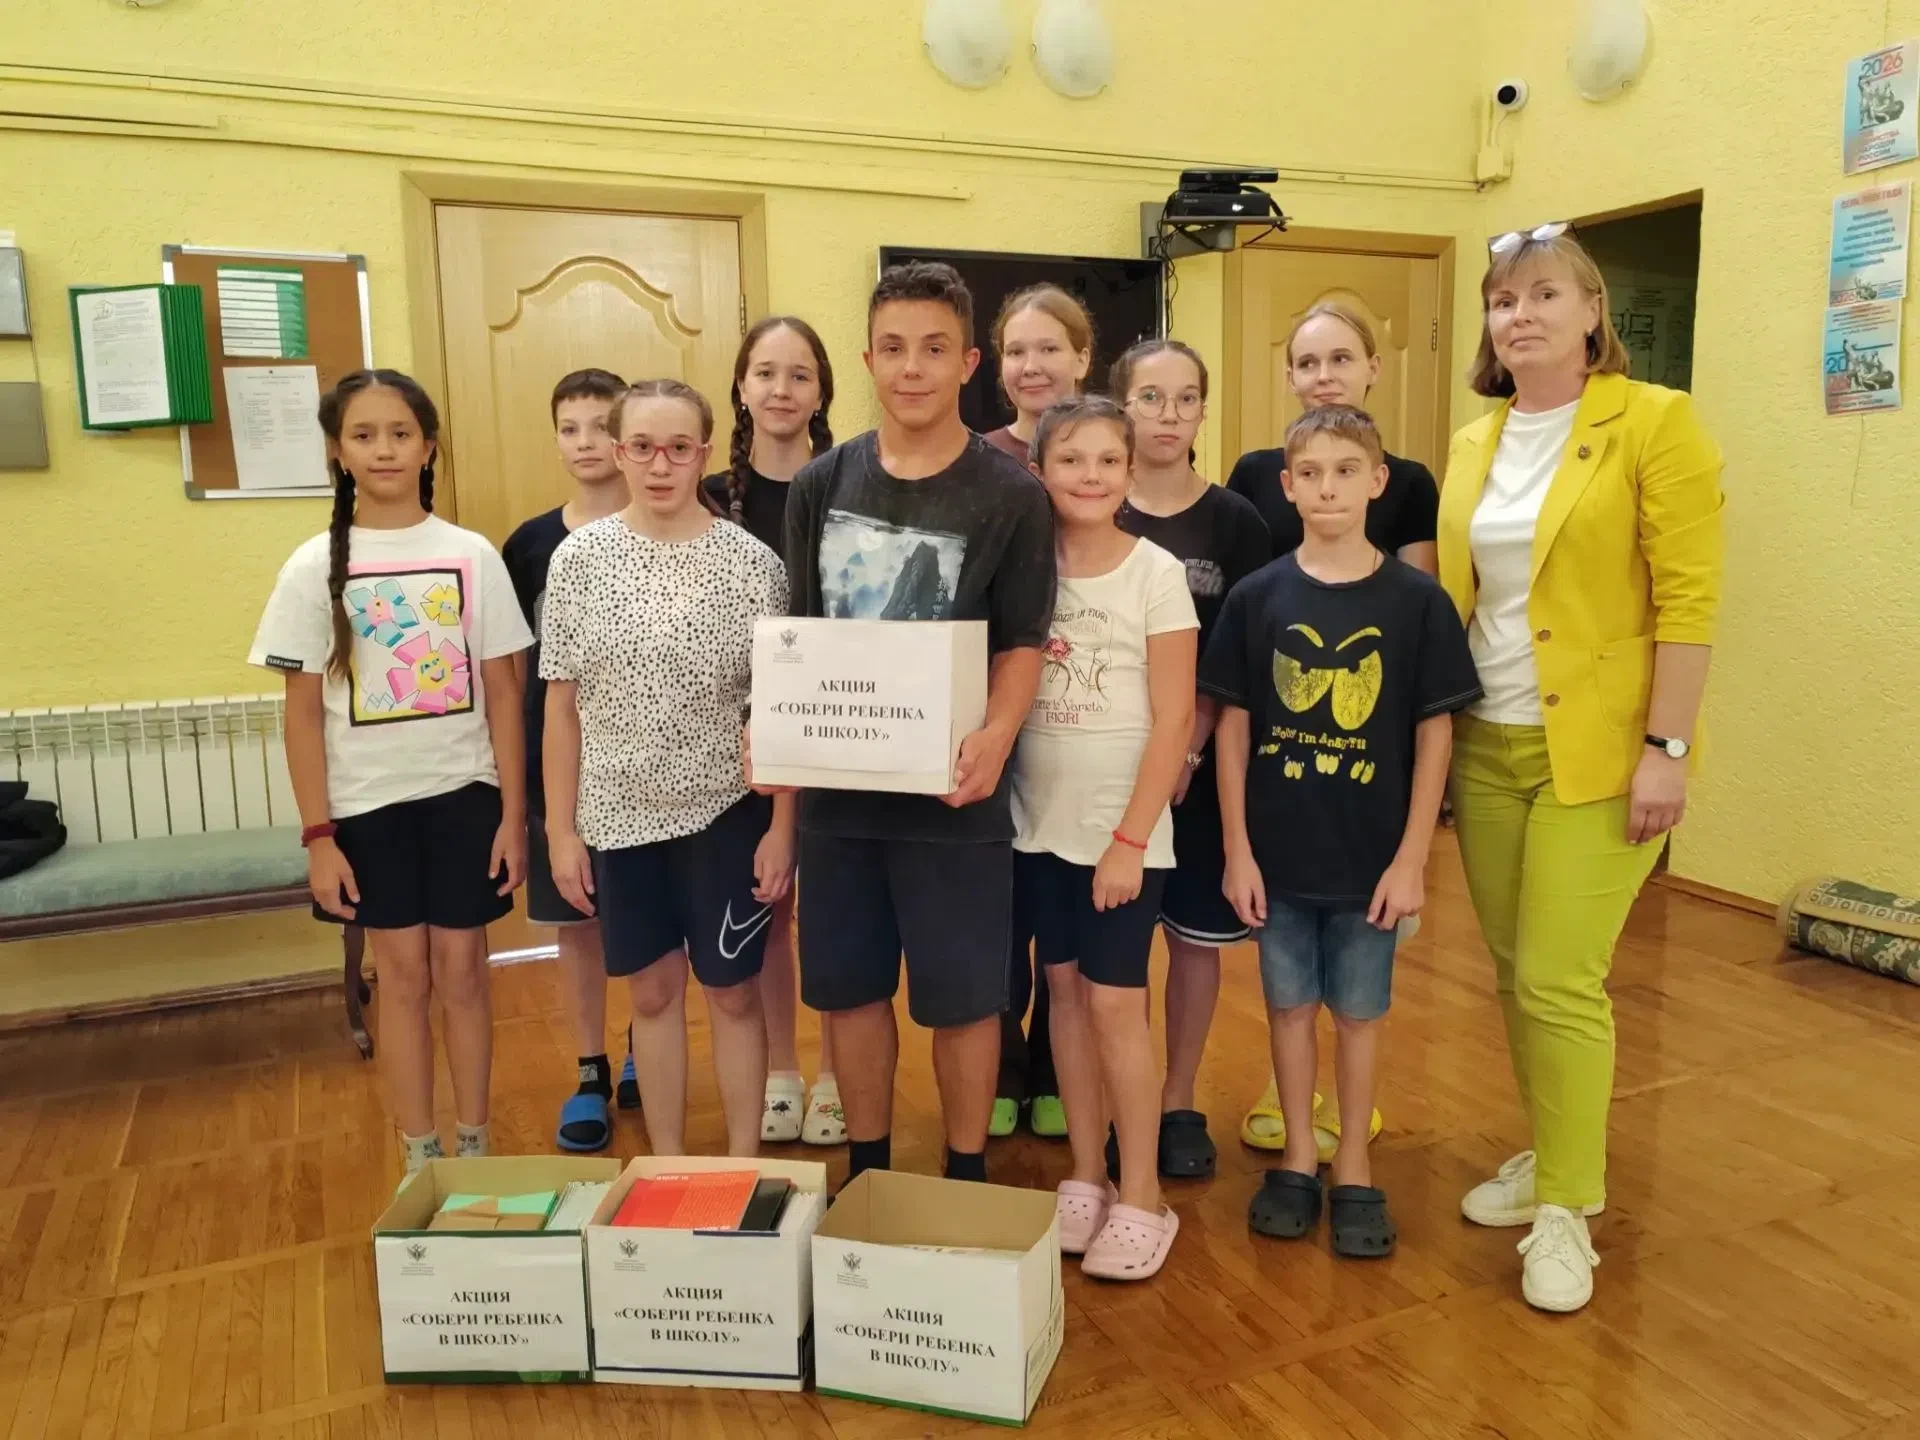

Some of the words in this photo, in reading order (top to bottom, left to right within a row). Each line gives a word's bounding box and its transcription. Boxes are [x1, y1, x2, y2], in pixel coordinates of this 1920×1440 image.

[1861, 52, 1904, 77] 2026
[1088, 607, 1108, 624] FIORI
[818, 679, 876, 694] АКЦИЯ
[770, 701, 843, 717] «СОБЕРИ
[848, 704, 925, 720] РЕБЕНКА
[1046, 711, 1079, 724] FIORI
[803, 725, 813, 737] В
[818, 725, 890, 741] ШКОЛУ»
[1298, 732, 1316, 744] I'm
[450, 1291, 510, 1305] АКЦИЯ
[663, 1286, 722, 1301] АКЦИЯ
[402, 1313, 478, 1326] «СОБЕРИ
[484, 1313, 563, 1325] РЕБЕНКА
[614, 1307, 690, 1321] «СОБЕРИ
[696, 1310, 775, 1325] РЕБЕНКА
[883, 1307, 943, 1326] АКЦИЯ
[439, 1334, 449, 1345] В
[454, 1333, 529, 1346] ШКОЛУ»
[651, 1328, 661, 1340] В
[666, 1329, 740, 1344] ШКОЛУ»
[835, 1323, 910, 1345] «СОБЕРИ
[916, 1335, 996, 1358] РЕБЕНКА
[870, 1349, 880, 1361] В
[885, 1351, 960, 1374] ШКОЛУ»
